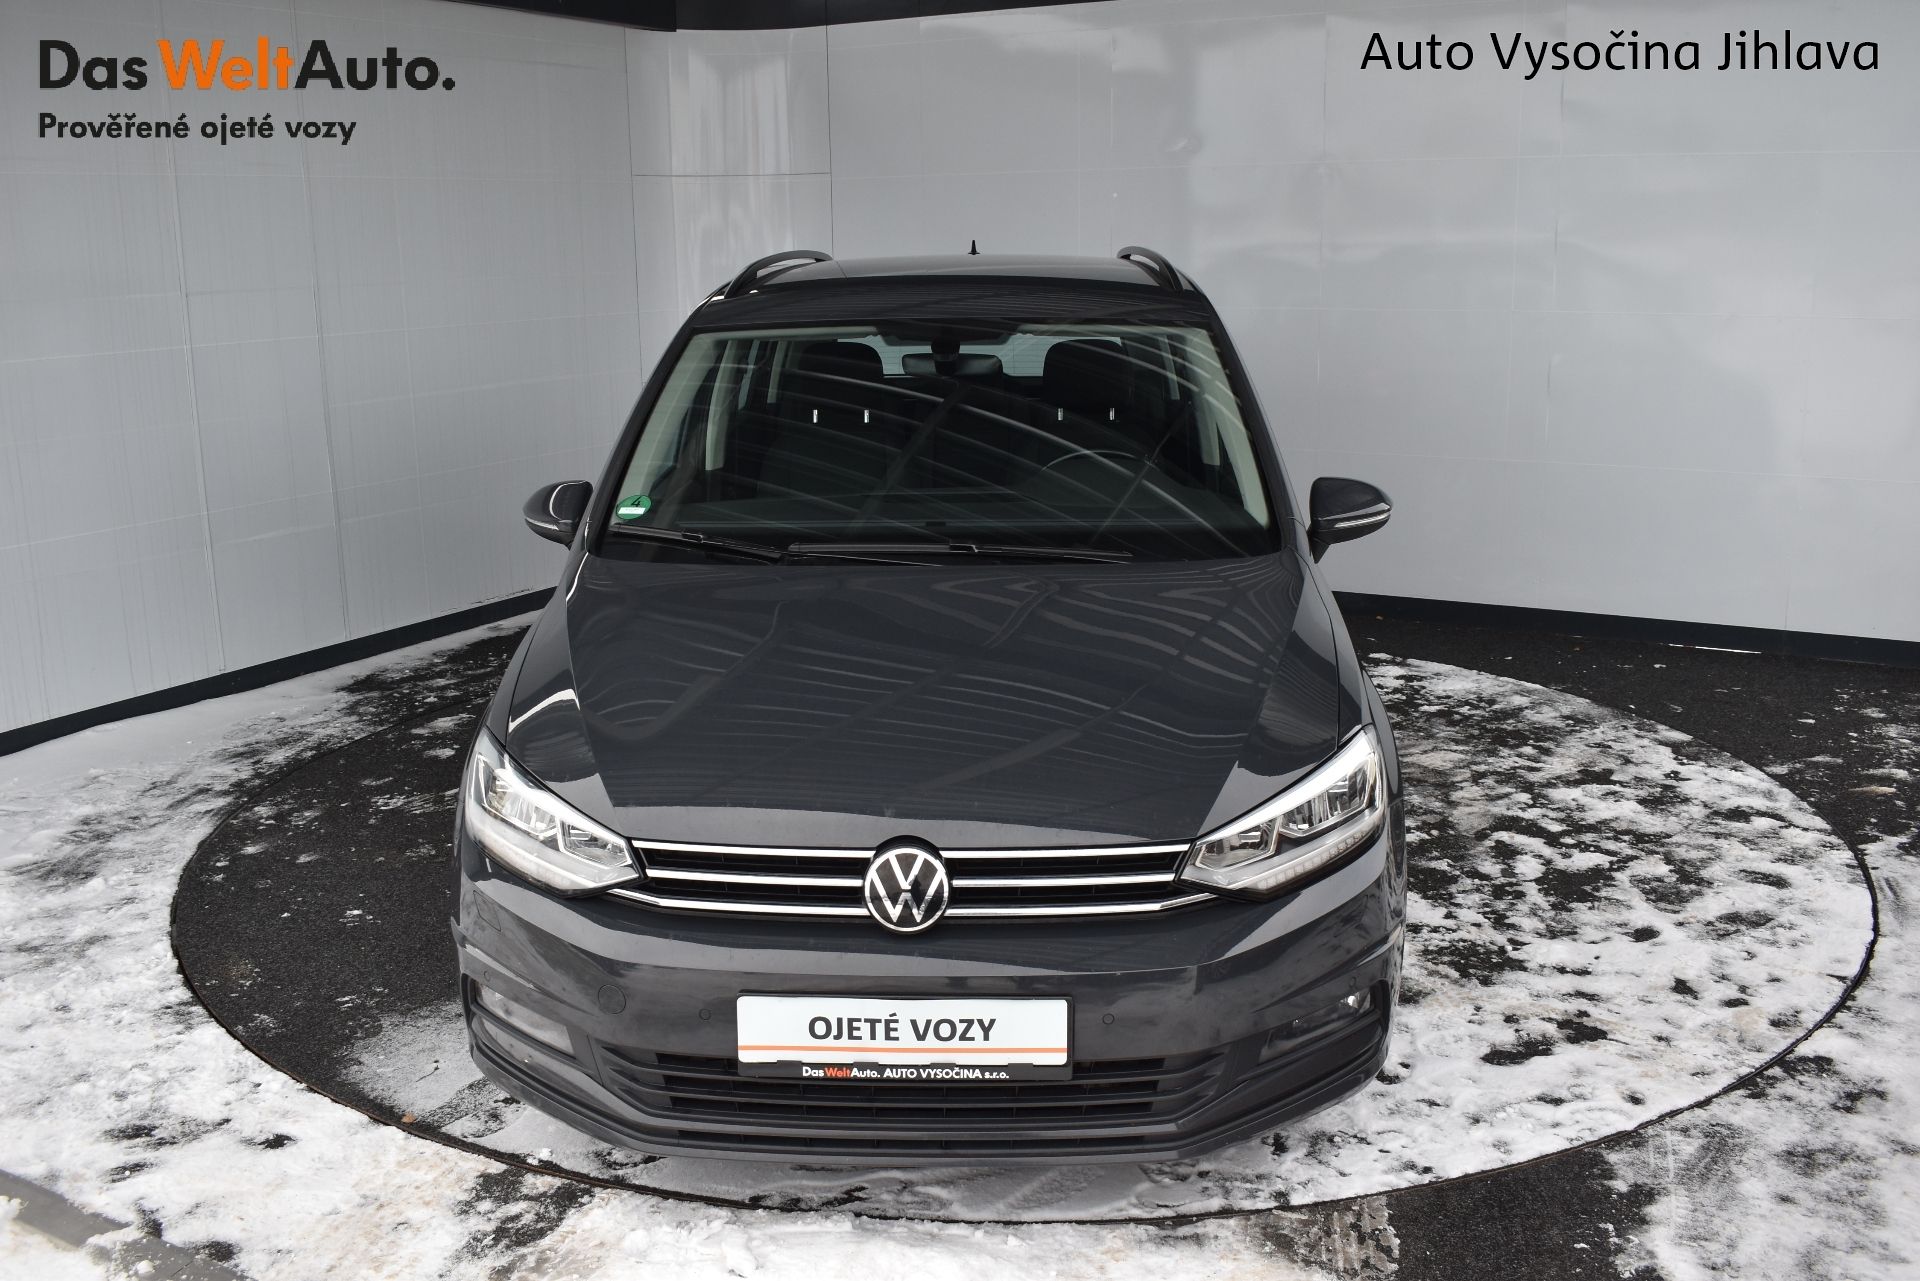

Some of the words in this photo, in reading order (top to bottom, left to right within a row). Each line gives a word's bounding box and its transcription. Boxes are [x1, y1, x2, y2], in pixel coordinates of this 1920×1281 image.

[631, 496, 642, 507] 4
[808, 1012, 900, 1041] OJETÉ
[909, 1018, 997, 1042] VOZY
[883, 1067, 917, 1079] AUTO
[920, 1067, 982, 1079] VYSOČINA
[984, 1071, 1010, 1079] s.r.o.
